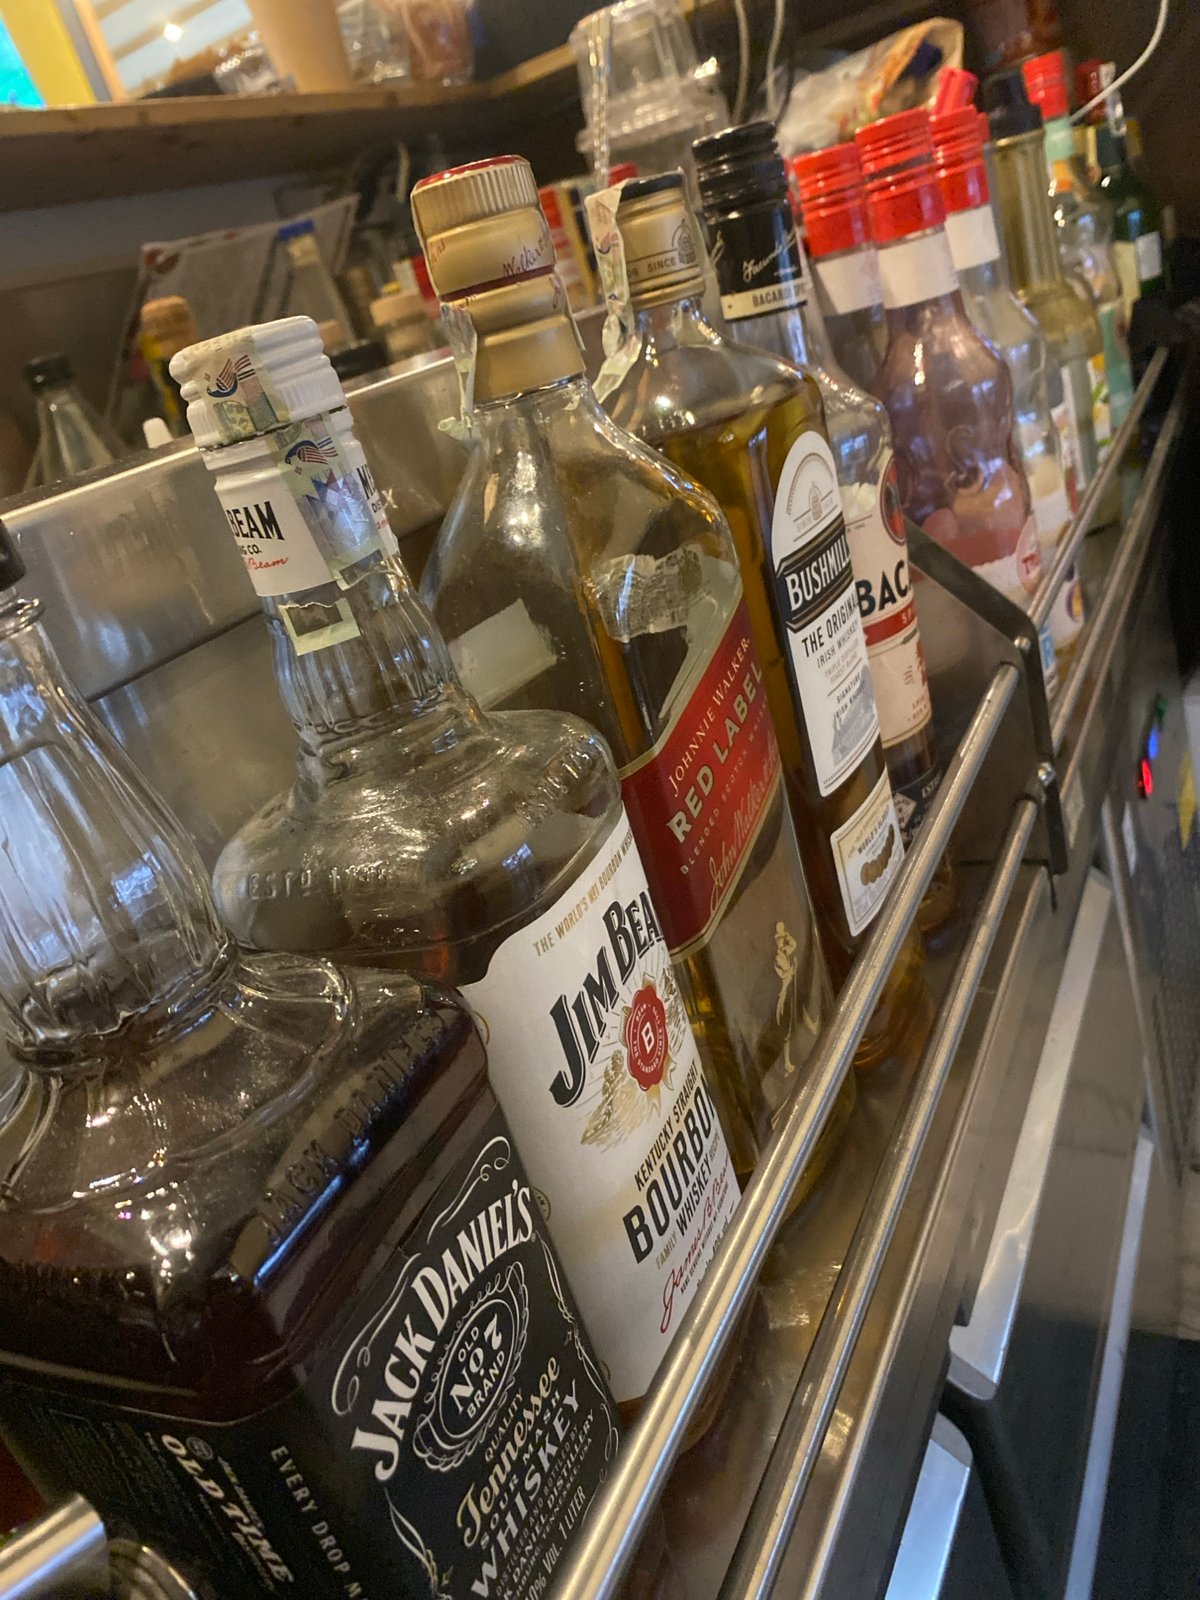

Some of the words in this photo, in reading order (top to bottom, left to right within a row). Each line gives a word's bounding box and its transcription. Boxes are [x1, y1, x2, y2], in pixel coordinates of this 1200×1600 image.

[647, 256, 677, 273] SINCE
[226, 501, 285, 541] BEAM
[855, 559, 912, 618] BAC
[801, 626, 824, 658] THE
[816, 643, 836, 669] IRISH
[837, 619, 858, 649] WHISKEY
[665, 764, 715, 844] RED
[712, 660, 763, 765] LABEL
[668, 706, 716, 798] JOHNNIE
[680, 807, 720, 876] BLENDED
[720, 749, 747, 802] SCOTCH
[532, 932, 556, 957] THE
[555, 896, 589, 940] WORLD'S
[598, 854, 623, 890] BOURBON
[549, 946, 620, 1108] JIM
[602, 888, 664, 986] BEA
[641, 1021, 655, 1055] B
[634, 1116, 674, 1192] KENTUCKY
[672, 1058, 699, 1125] STRAIGHT
[655, 1230, 679, 1271] FAMILY
[676, 1152, 713, 1238] WHISKEY
[351, 1313, 436, 1481] JACK
[411, 1178, 533, 1336] DANIEL'S
[458, 1326, 479, 1362] OLD
[467, 1350, 505, 1419] BRAND
[485, 1389, 523, 1462] QUALITY
[161, 1434, 225, 1500] OLD
[456, 1355, 560, 1548] Tennessee
[471, 1379, 579, 1598] WHISKEY
[480, 1474, 519, 1551] SOUR
[523, 1390, 561, 1465] MASH
[513, 1510, 548, 1584] DANIEL
[547, 1408, 595, 1510] DISTILLERY
[528, 1497, 544, 1528] AND
[543, 1441, 571, 1497] BOTTLED
[270, 1446, 319, 1514] EVERY
[311, 1520, 350, 1573] DROP
[542, 1543, 563, 1574] VOL.
[564, 1485, 586, 1531] LITER
